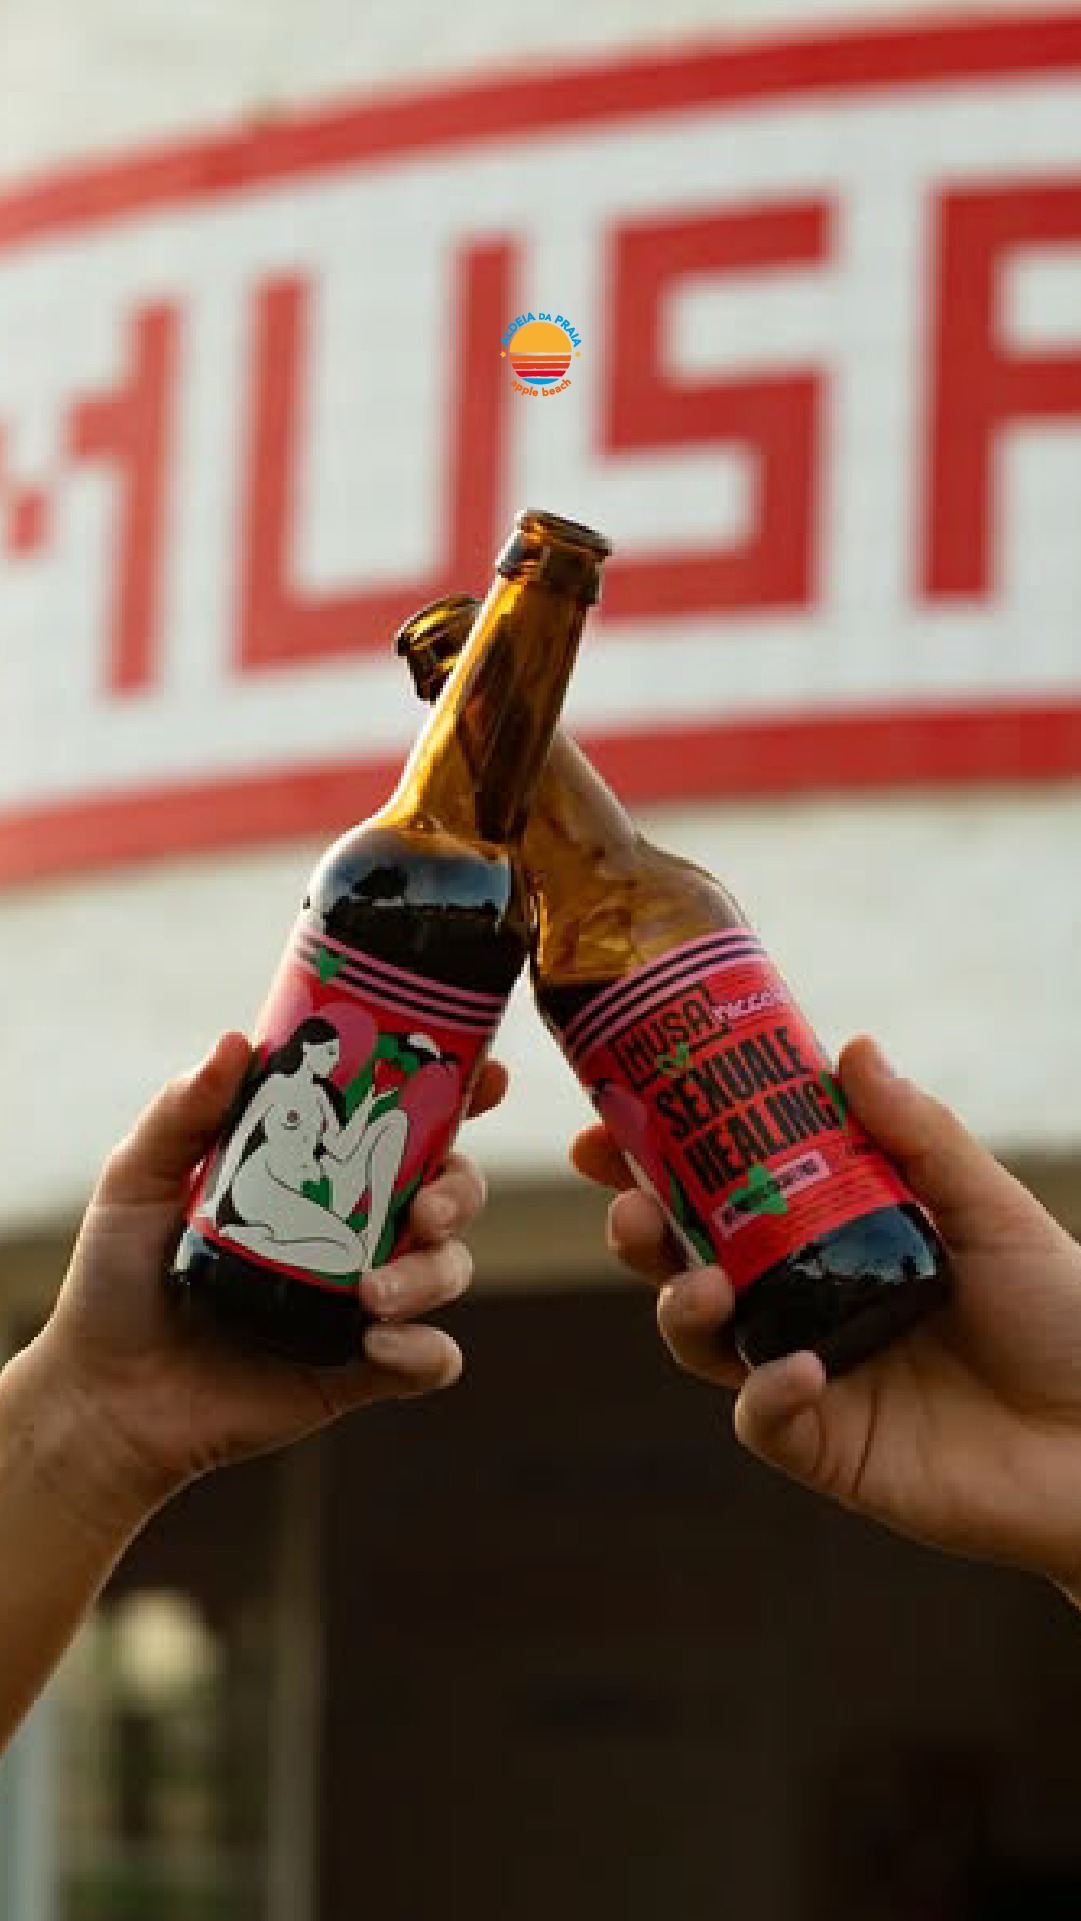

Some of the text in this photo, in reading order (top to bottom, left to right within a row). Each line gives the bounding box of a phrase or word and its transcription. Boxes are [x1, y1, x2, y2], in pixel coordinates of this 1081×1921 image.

[621, 997, 712, 1078] MUSA
[653, 1026, 812, 1140] SEXUALE
[684, 1081, 841, 1194] HEALING
